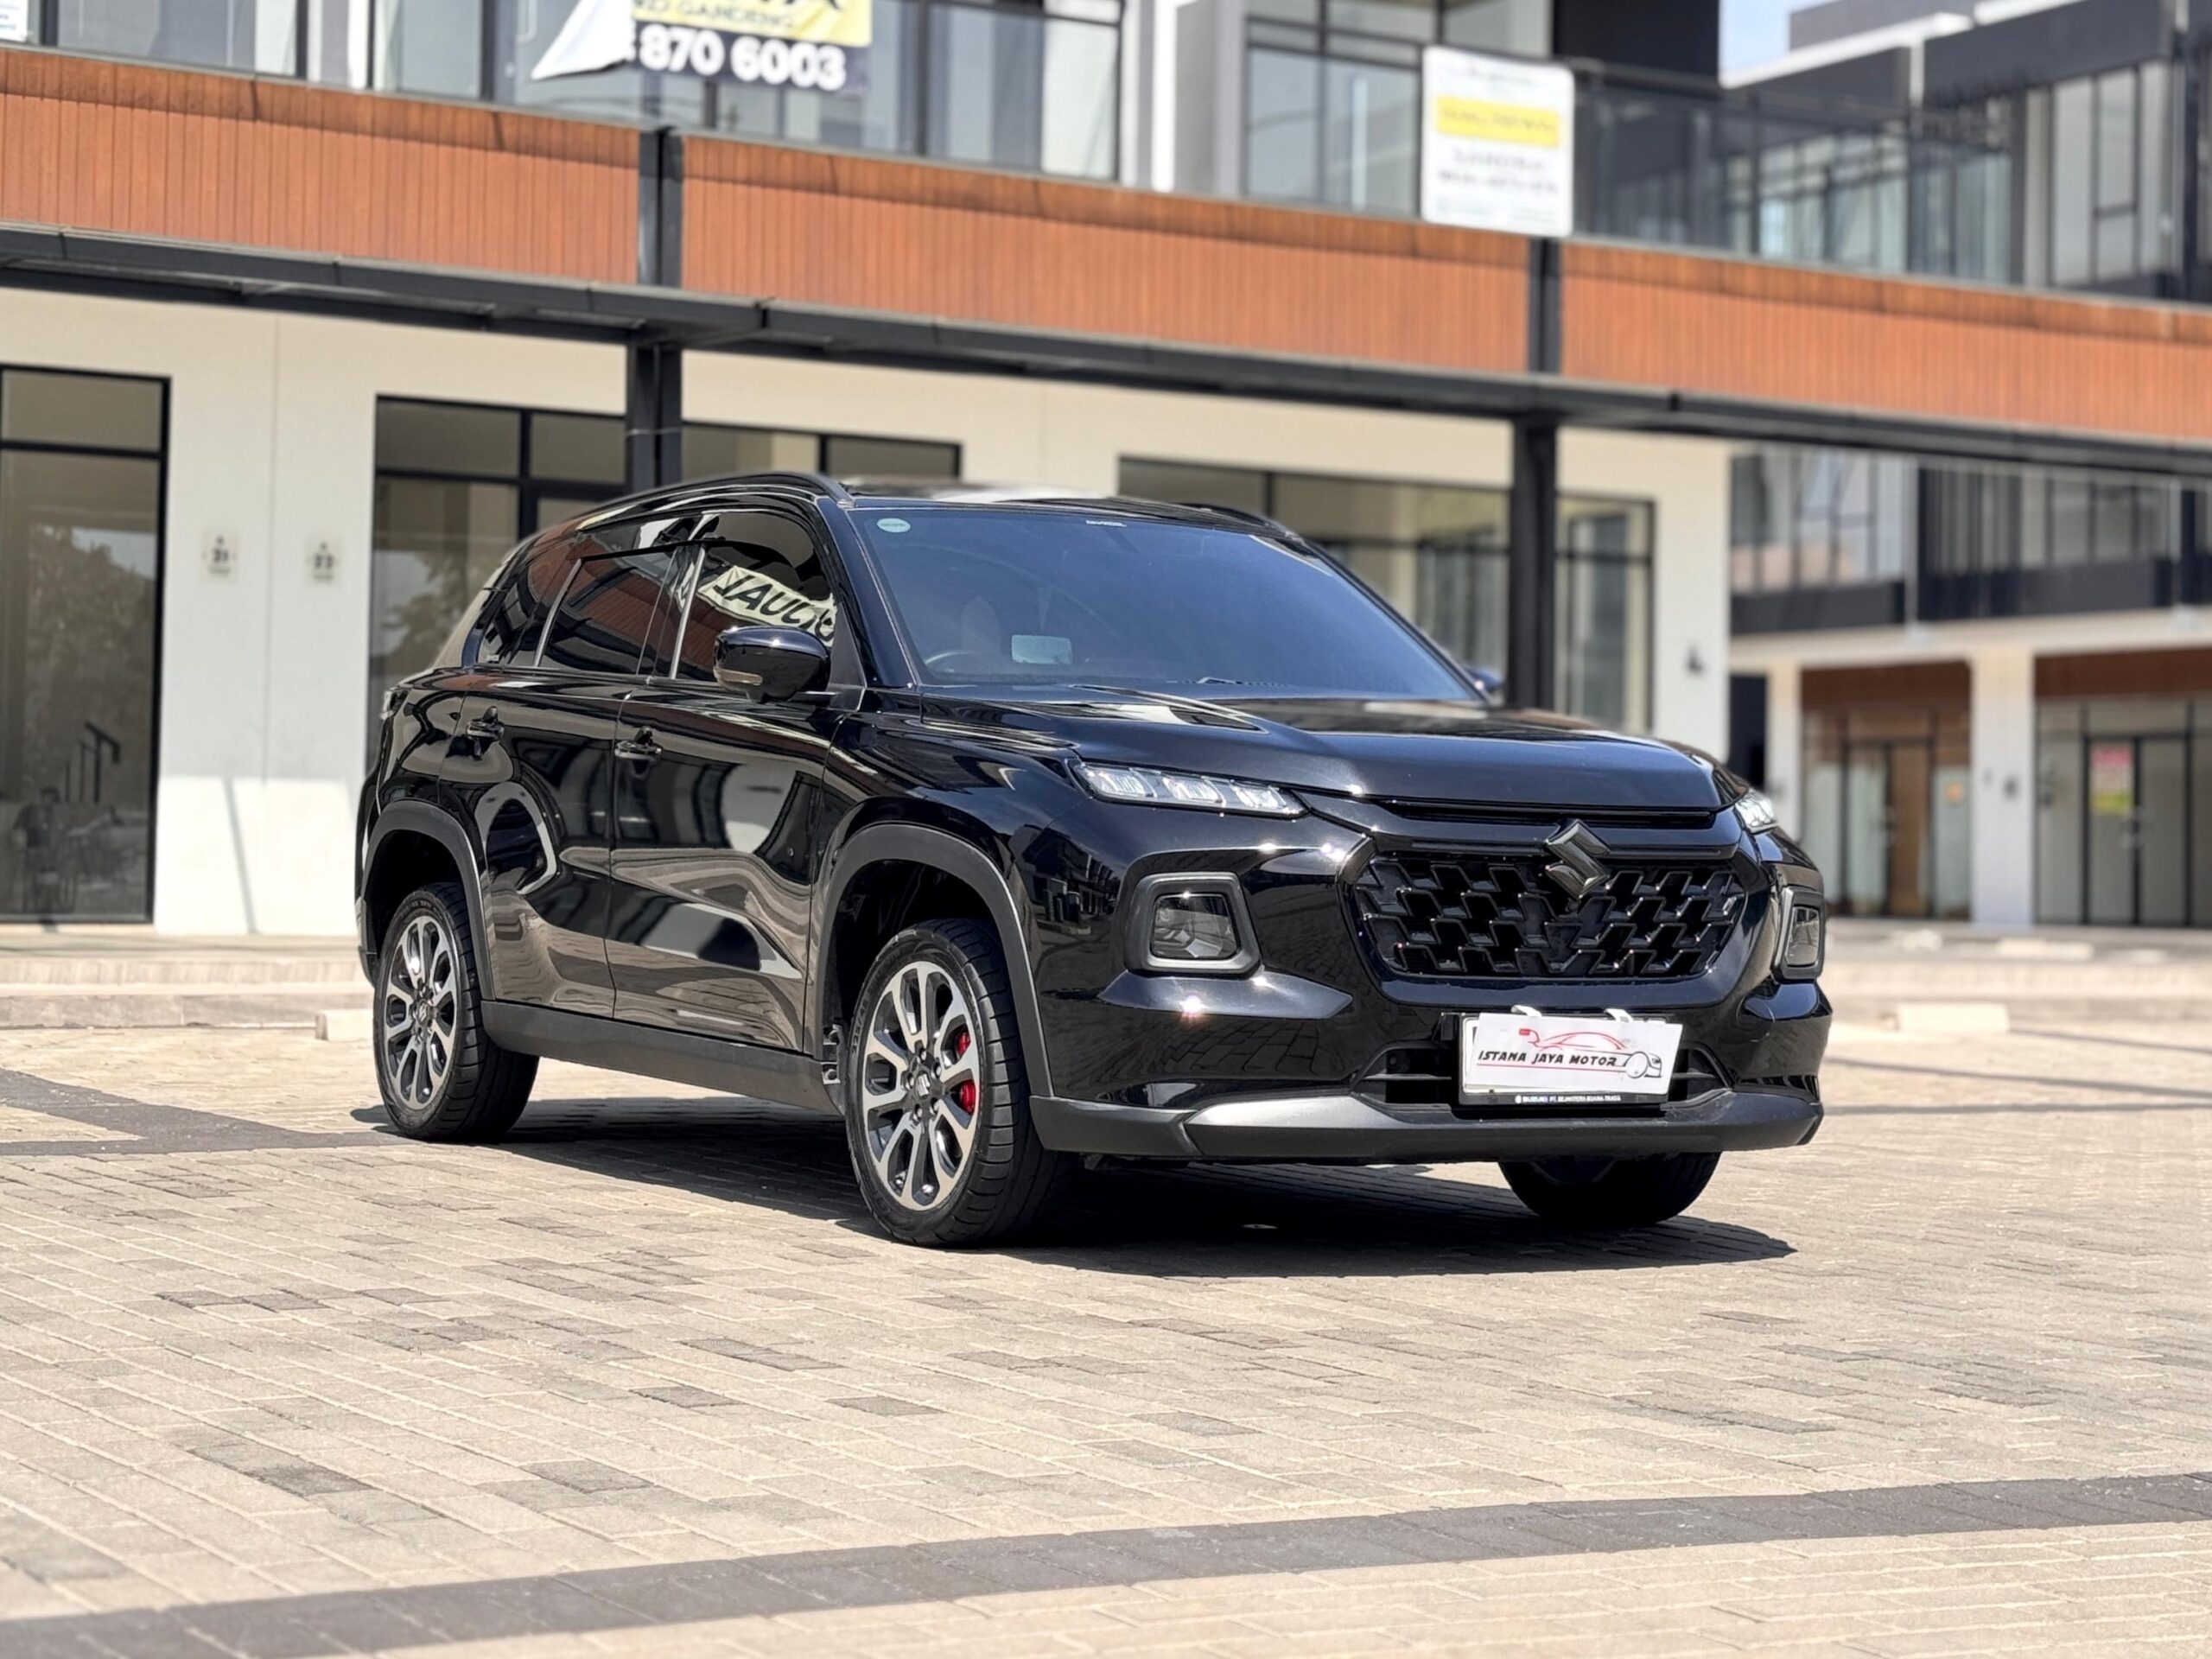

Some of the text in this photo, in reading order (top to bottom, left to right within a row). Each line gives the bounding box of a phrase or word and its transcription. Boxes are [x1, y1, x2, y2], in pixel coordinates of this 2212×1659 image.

[730, 35, 847, 91] 6003
[1478, 1050, 1618, 1066] ISTANA JAYA MOTOR
